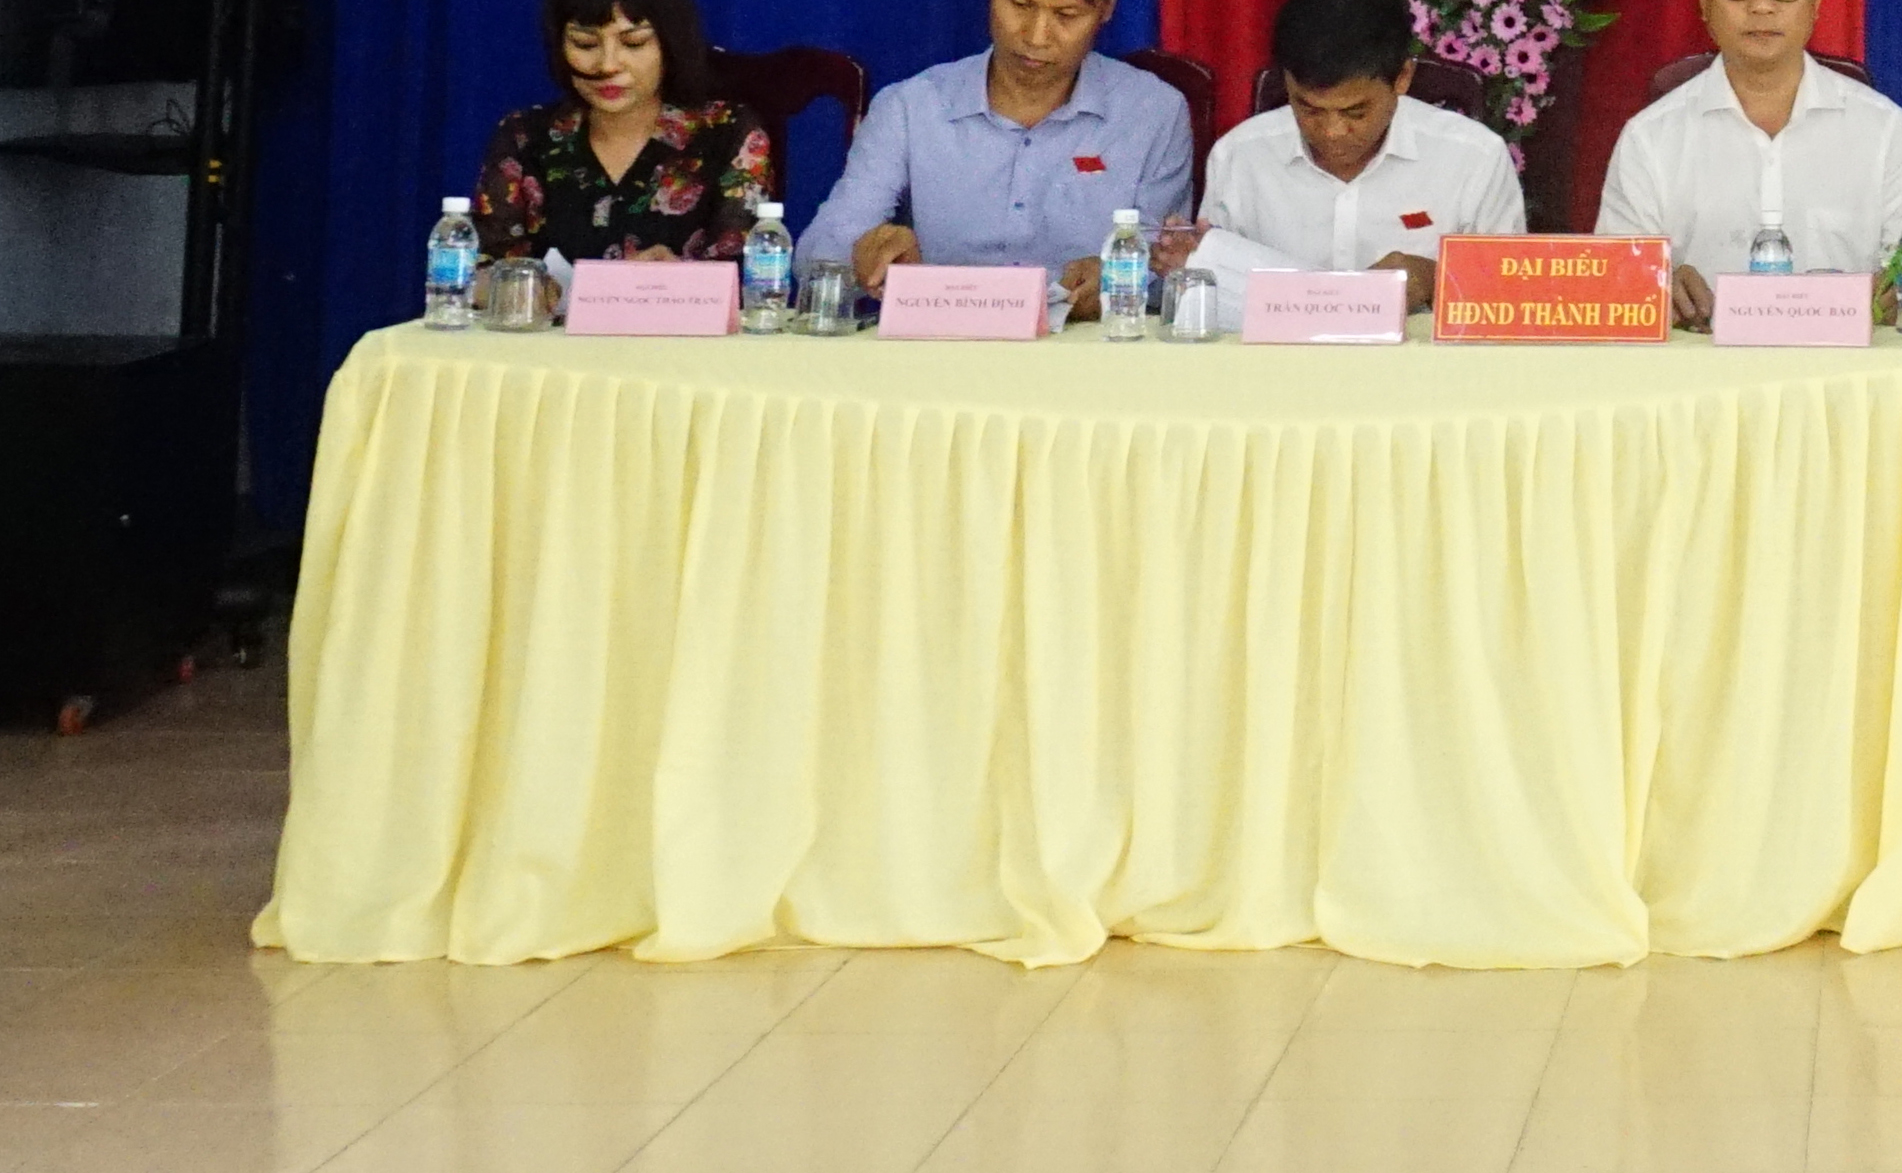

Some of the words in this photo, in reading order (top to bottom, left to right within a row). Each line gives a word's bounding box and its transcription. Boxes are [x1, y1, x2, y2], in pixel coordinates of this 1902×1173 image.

[1500, 257, 1544, 280] ĐẠI
[1550, 249, 1608, 277] BIỂU
[1447, 302, 1515, 325] HĐND
[1520, 295, 1601, 326] THÀNH
[1606, 294, 1657, 326] PHỐ
